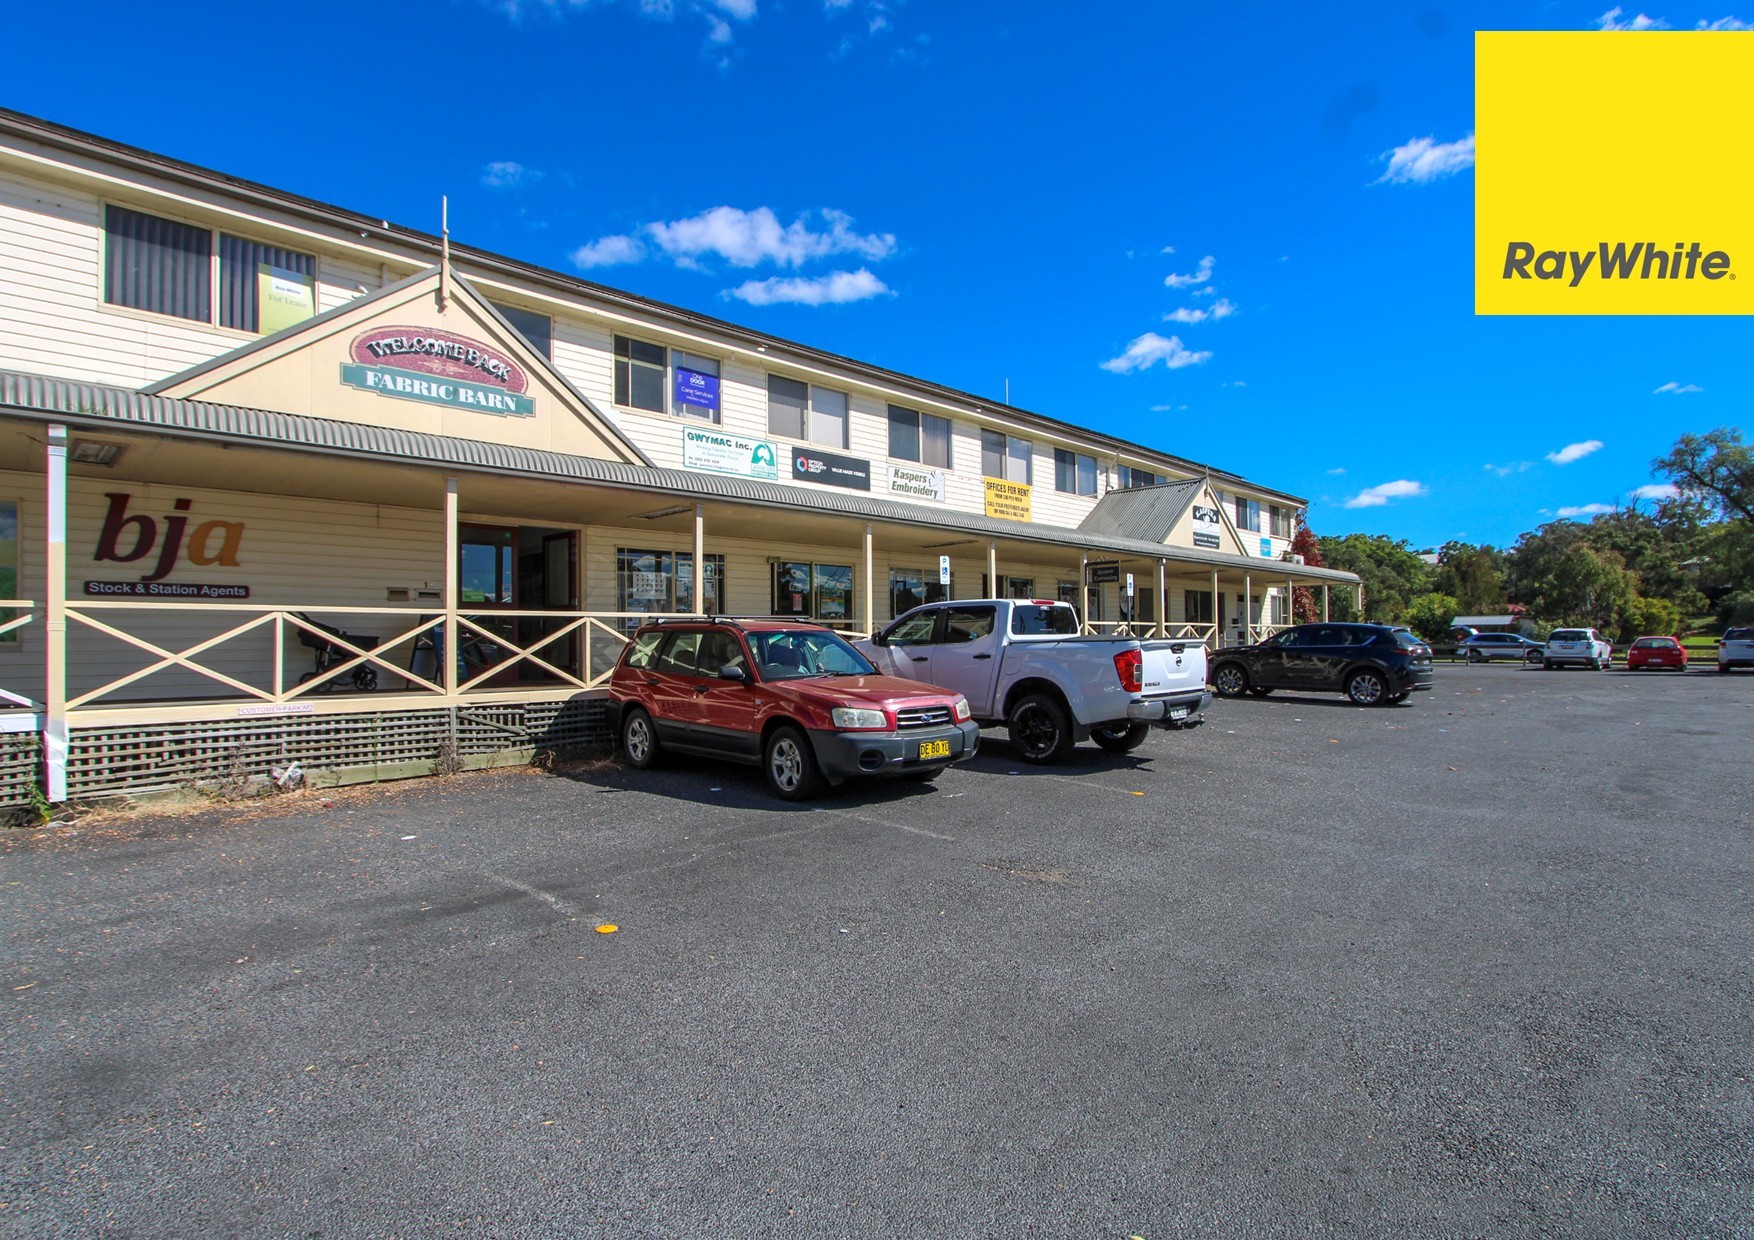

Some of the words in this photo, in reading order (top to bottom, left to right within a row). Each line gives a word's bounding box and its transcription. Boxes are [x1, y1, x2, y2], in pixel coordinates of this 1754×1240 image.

[365, 336, 466, 360] WELCOME
[465, 347, 513, 383] BACK
[365, 370, 454, 400] FABRIC
[458, 387, 517, 411] BARN
[687, 431, 732, 447] GWYMAC
[735, 441, 753, 451] Inc.
[893, 468, 927, 483] Kaspers
[891, 480, 938, 500] Embroidery
[986, 481, 1007, 493] OFFICES
[1007, 485, 1017, 495] FOR
[1017, 487, 1030, 498] RENT
[93, 493, 245, 581] bja
[89, 582, 131, 593] Stock
[135, 583, 146, 594] &
[150, 584, 198, 595] Station
[201, 585, 246, 597] Agents
